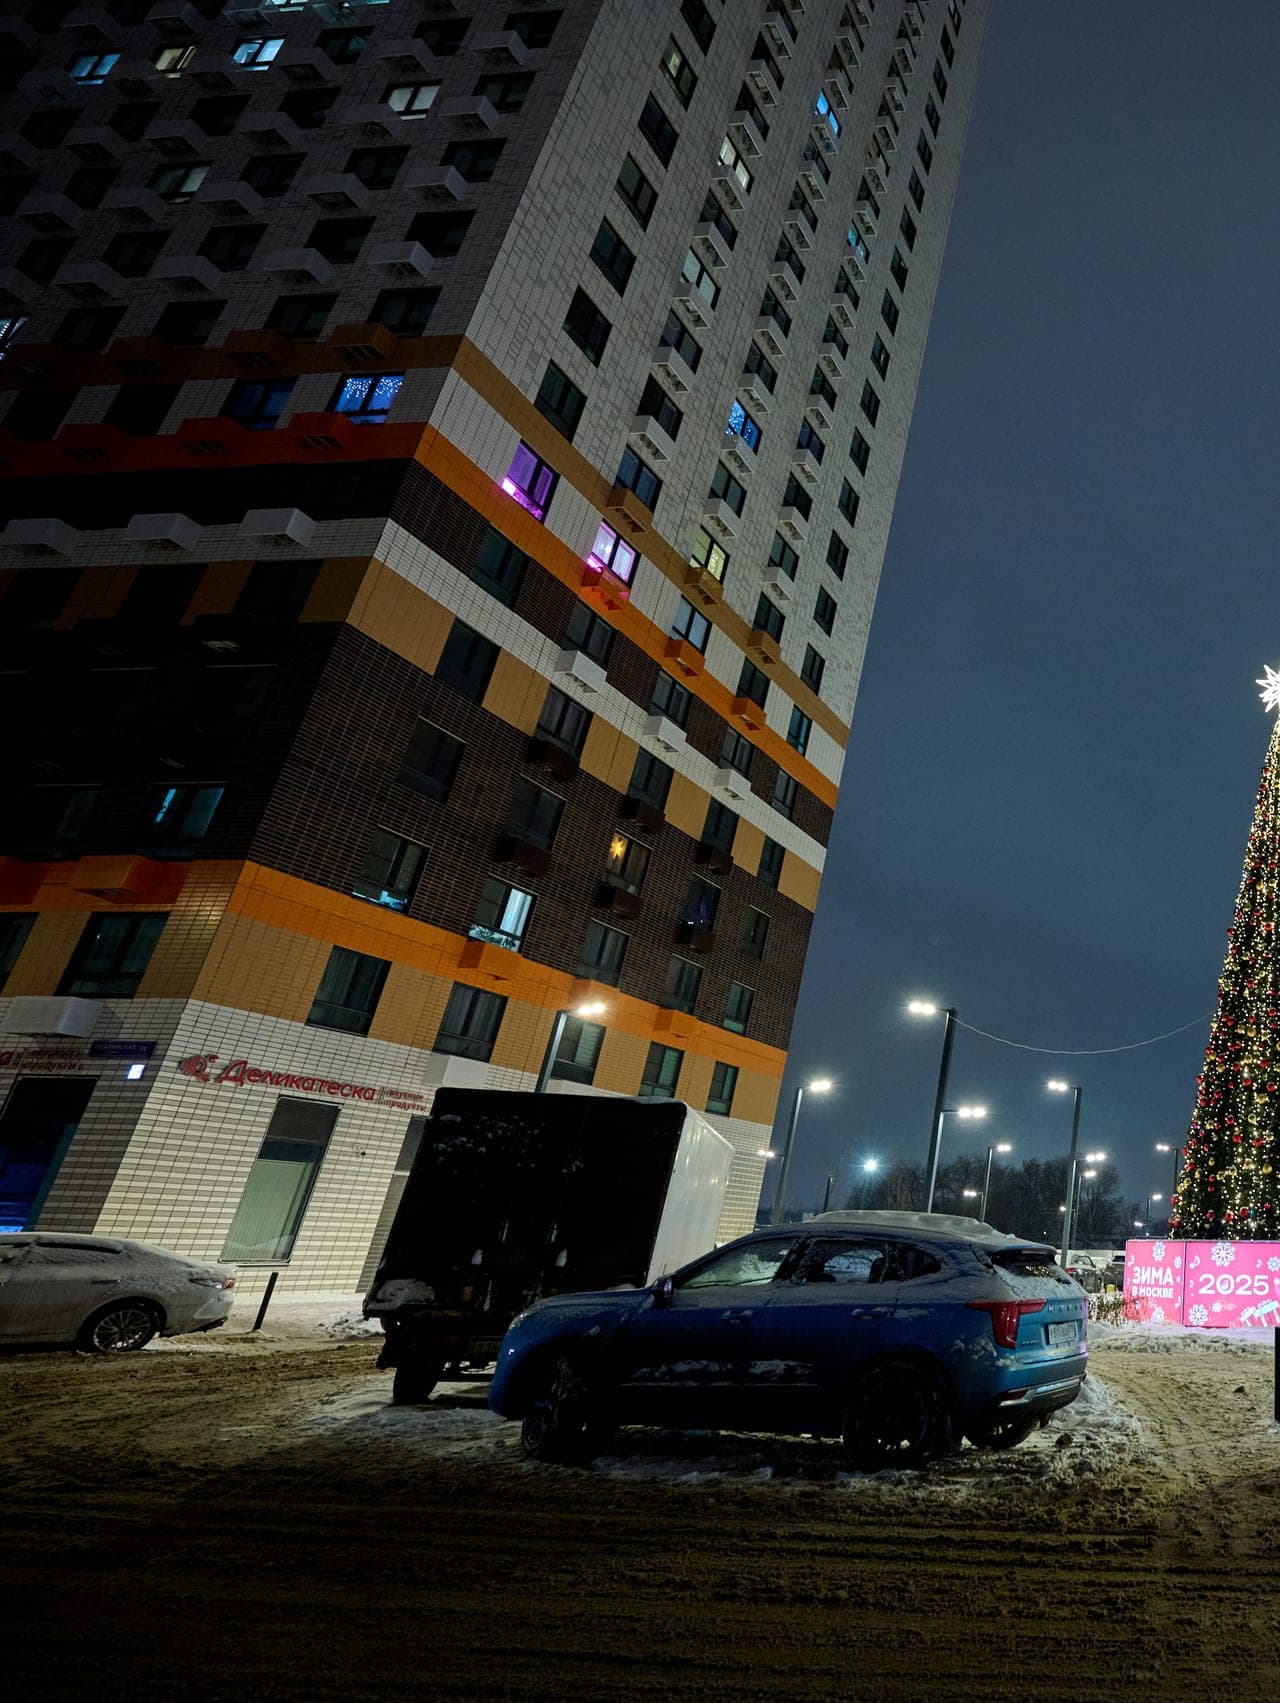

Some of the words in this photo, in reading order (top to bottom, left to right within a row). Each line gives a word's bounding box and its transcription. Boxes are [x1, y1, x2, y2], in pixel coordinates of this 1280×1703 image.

[219, 1060, 377, 1102] Деликатеска
[385, 1100, 427, 1112] продукты
[1132, 1266, 1174, 1286] ЗИМА
[1199, 1274, 1270, 1296] 2025
[1132, 1287, 1138, 1297] В
[1139, 1288, 1174, 1299] МОСКВЕ
